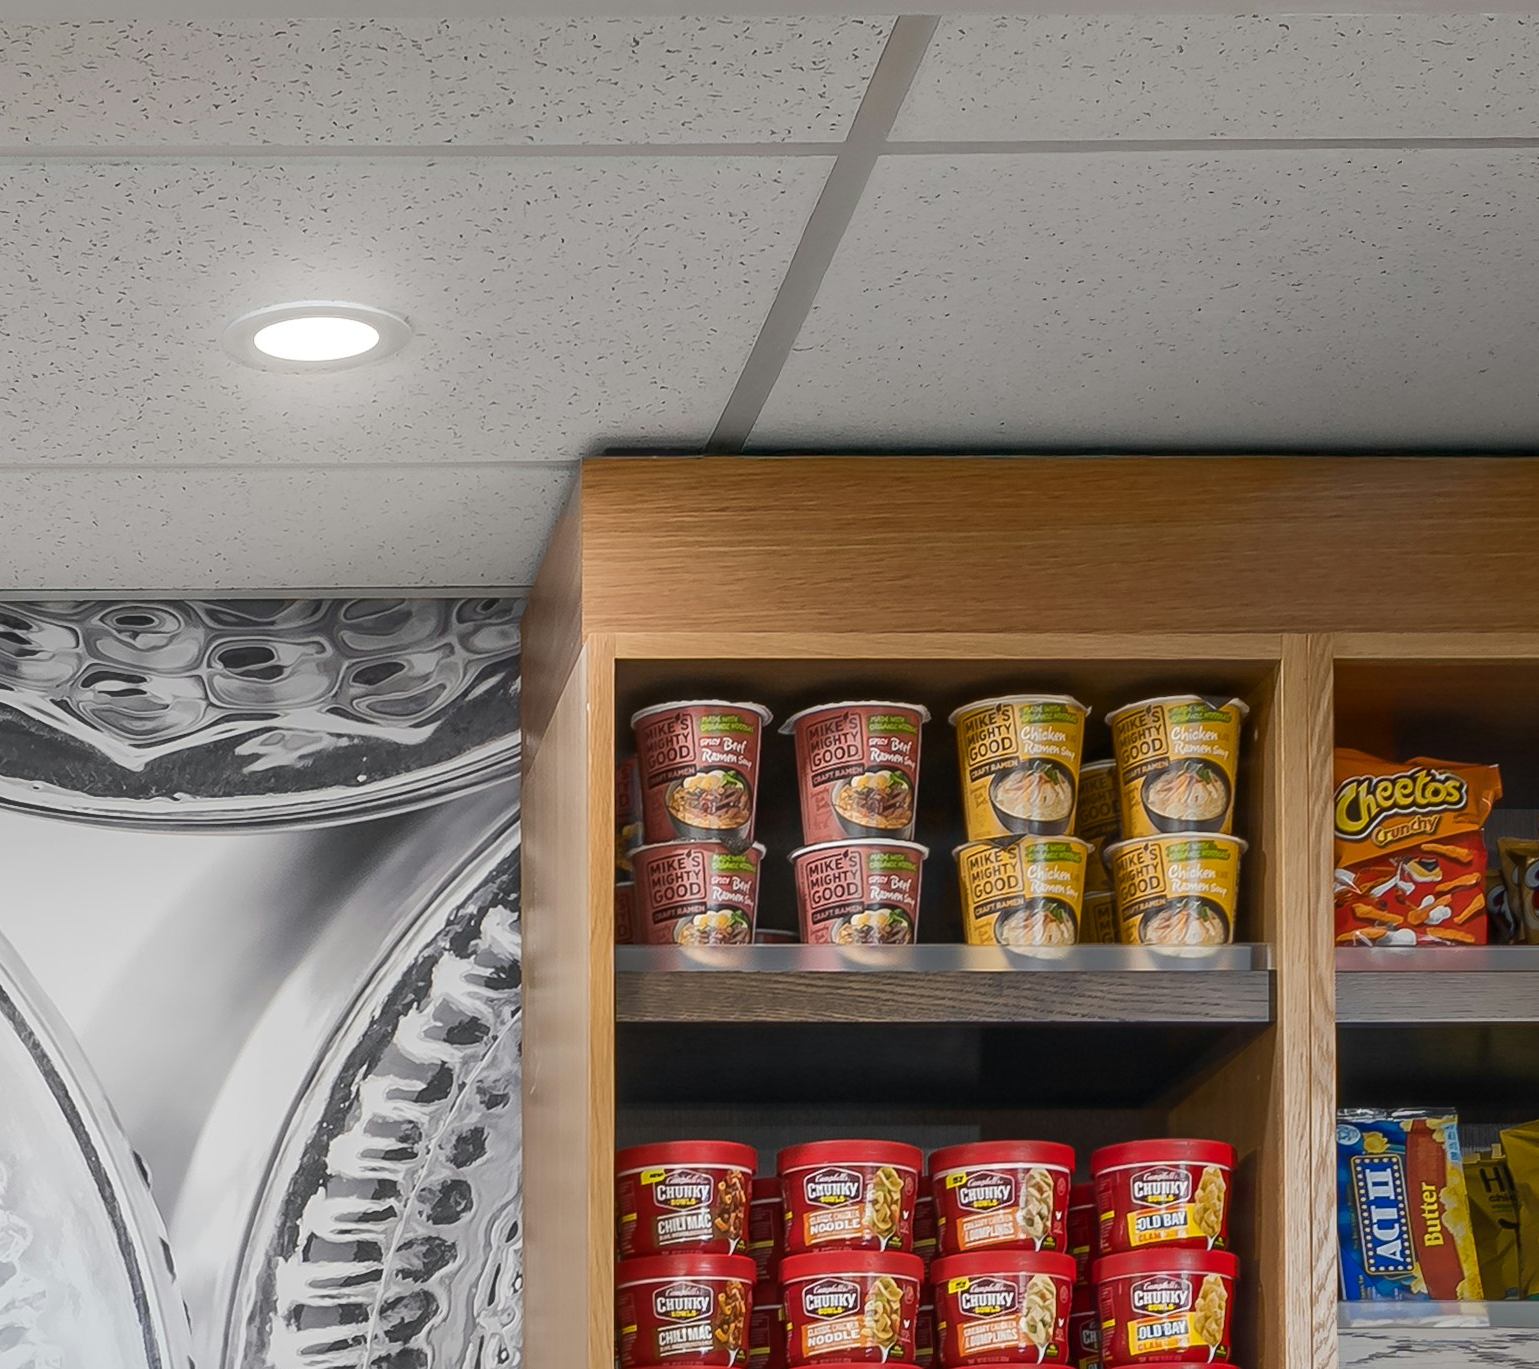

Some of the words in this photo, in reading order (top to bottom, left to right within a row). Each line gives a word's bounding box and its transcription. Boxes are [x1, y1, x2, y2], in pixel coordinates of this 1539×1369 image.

[810, 713, 858, 741] MIKE'S
[1022, 727, 1066, 742] Chicken
[811, 731, 858, 751] MIGHTY
[812, 745, 859, 766] GOOD
[1335, 773, 1466, 834] Cheetos
[1373, 814, 1439, 846] Crunchy
[657, 1184, 709, 1200] CHUNKY
[1424, 1181, 1446, 1247] Butter
[811, 1220, 860, 1234] NOODLE
